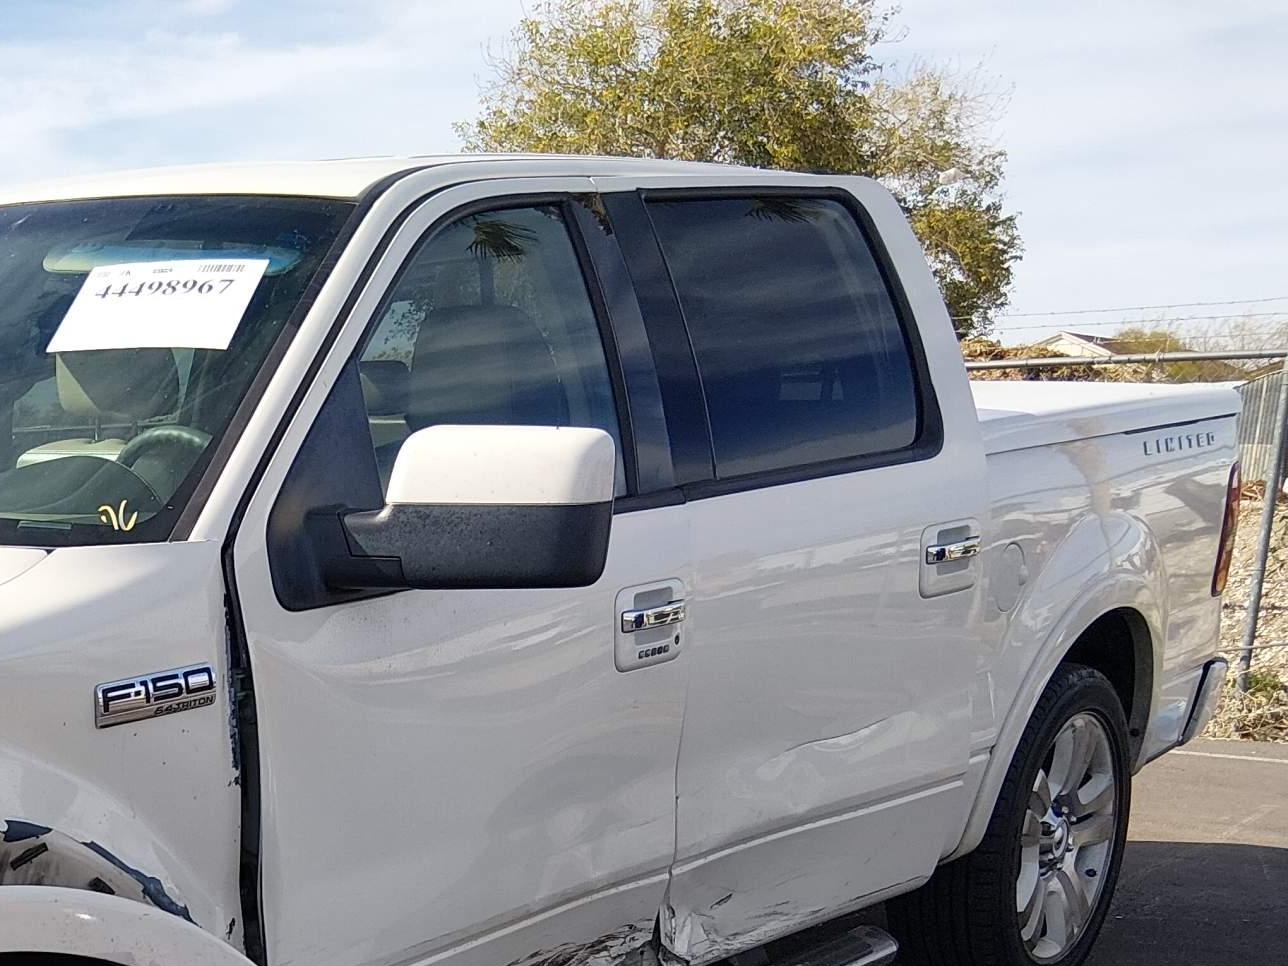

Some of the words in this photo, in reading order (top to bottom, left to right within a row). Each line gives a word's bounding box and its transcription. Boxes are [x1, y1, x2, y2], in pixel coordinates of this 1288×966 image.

[95, 278, 235, 299] 44498967
[1143, 431, 1215, 456] LIMITED
[101, 666, 214, 714] F-150
